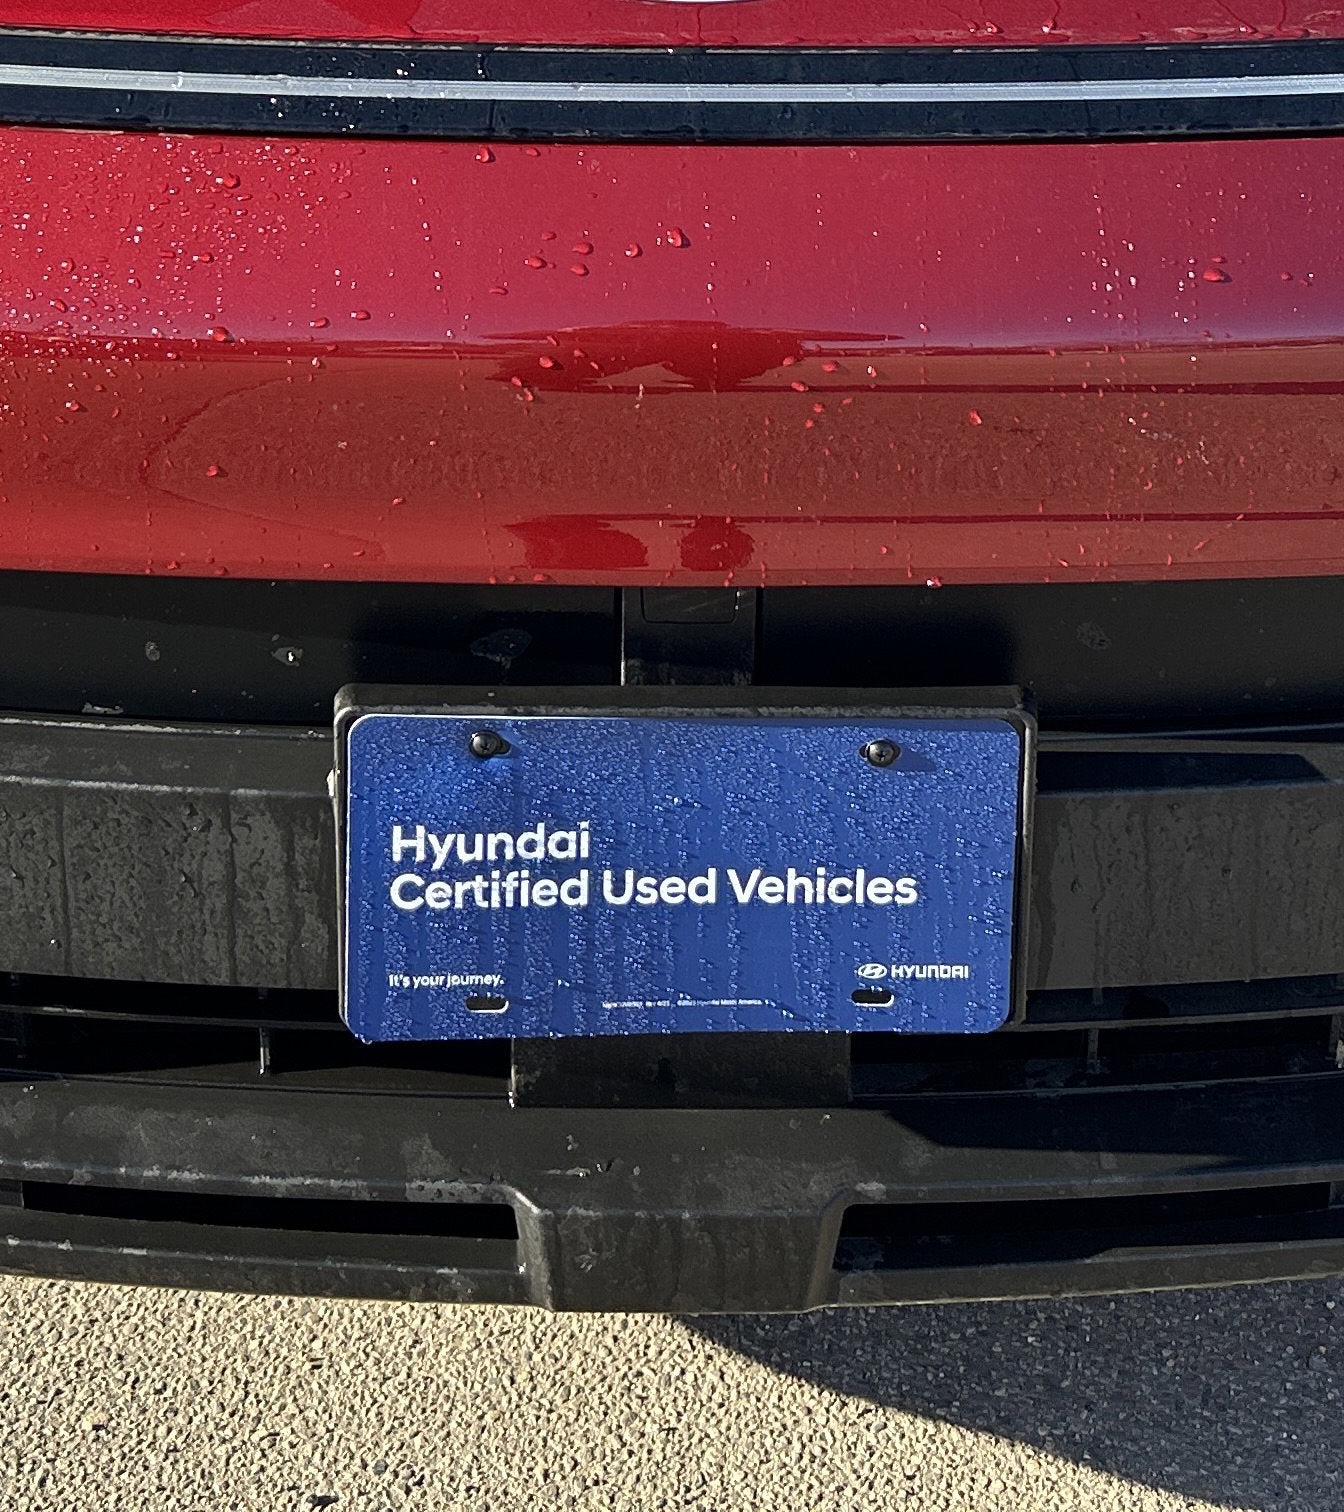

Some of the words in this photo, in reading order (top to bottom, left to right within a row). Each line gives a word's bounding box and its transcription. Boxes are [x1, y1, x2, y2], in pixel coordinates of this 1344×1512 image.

[392, 821, 590, 870] Hyundai
[390, 869, 589, 909] Certified
[603, 867, 717, 905] Used
[726, 867, 918, 905] Vehicles
[388, 973, 410, 987] It's
[412, 974, 446, 988] your
[446, 972, 505, 988] journey.
[890, 964, 969, 979] HYUNDAI
